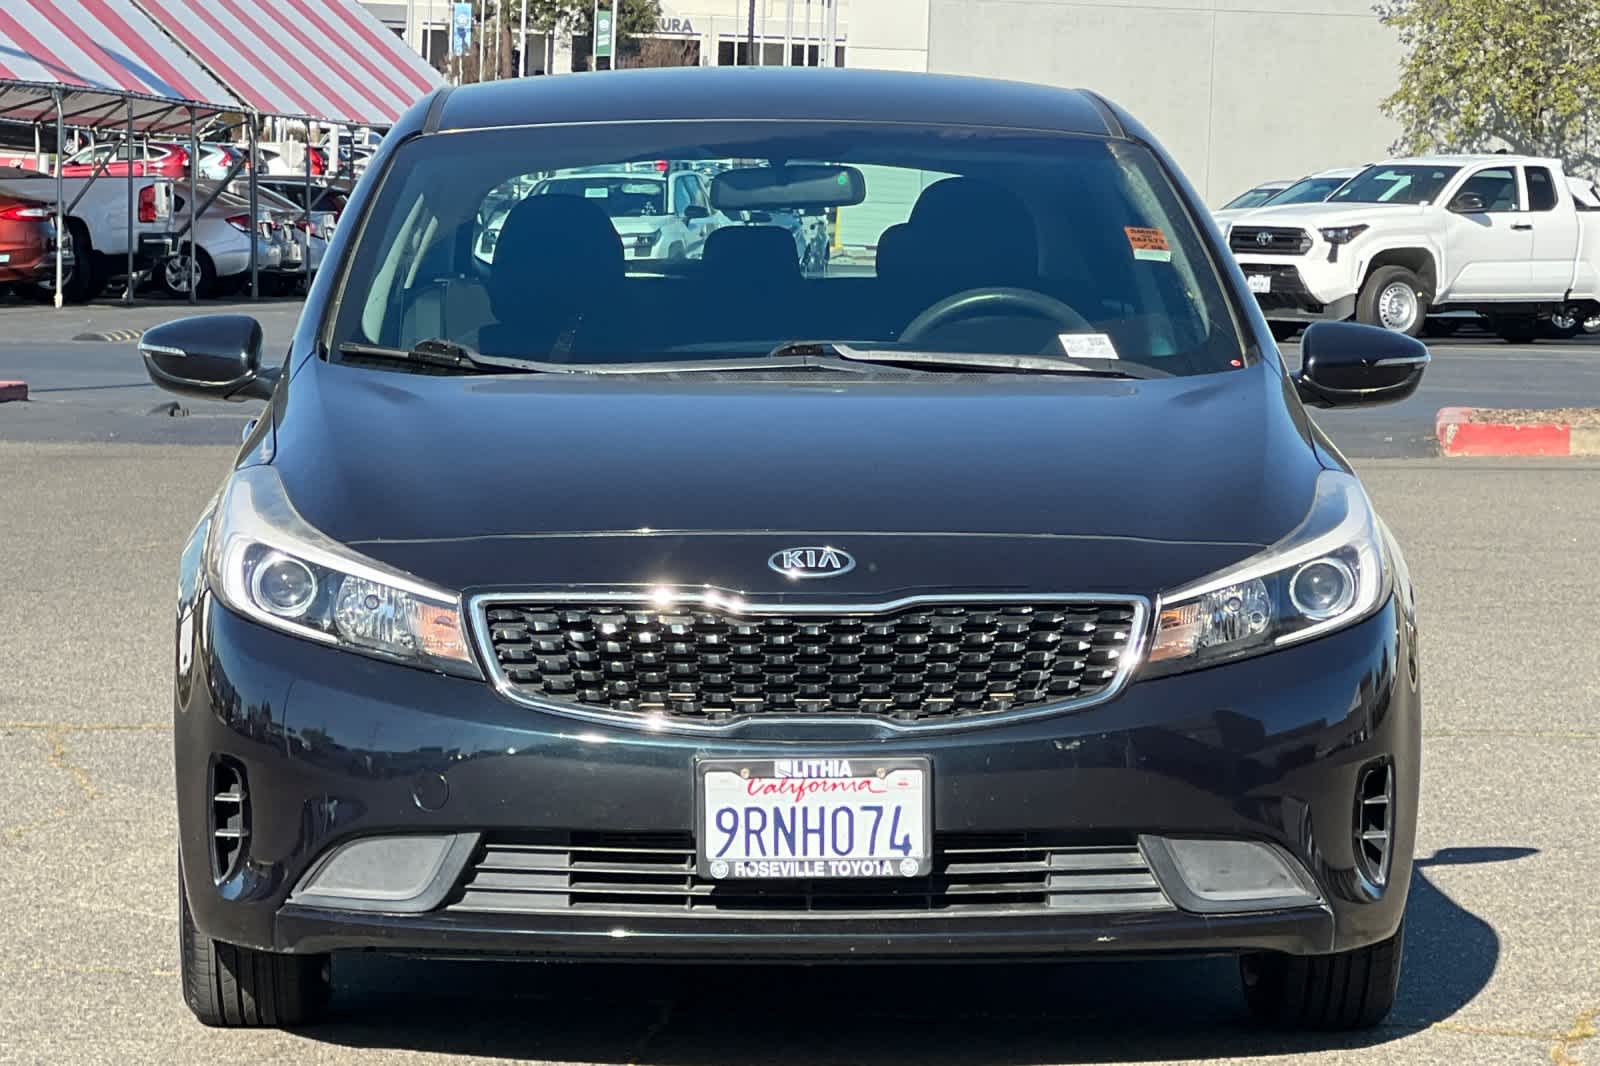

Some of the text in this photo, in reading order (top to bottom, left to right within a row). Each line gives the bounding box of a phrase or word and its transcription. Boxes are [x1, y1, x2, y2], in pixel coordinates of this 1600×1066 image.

[783, 550, 841, 569] KIA
[793, 760, 852, 777] LITHIA
[747, 777, 888, 802] California
[715, 806, 912, 857] 9RNH074
[735, 861, 894, 877] ROSEVILLE TOYOTA
